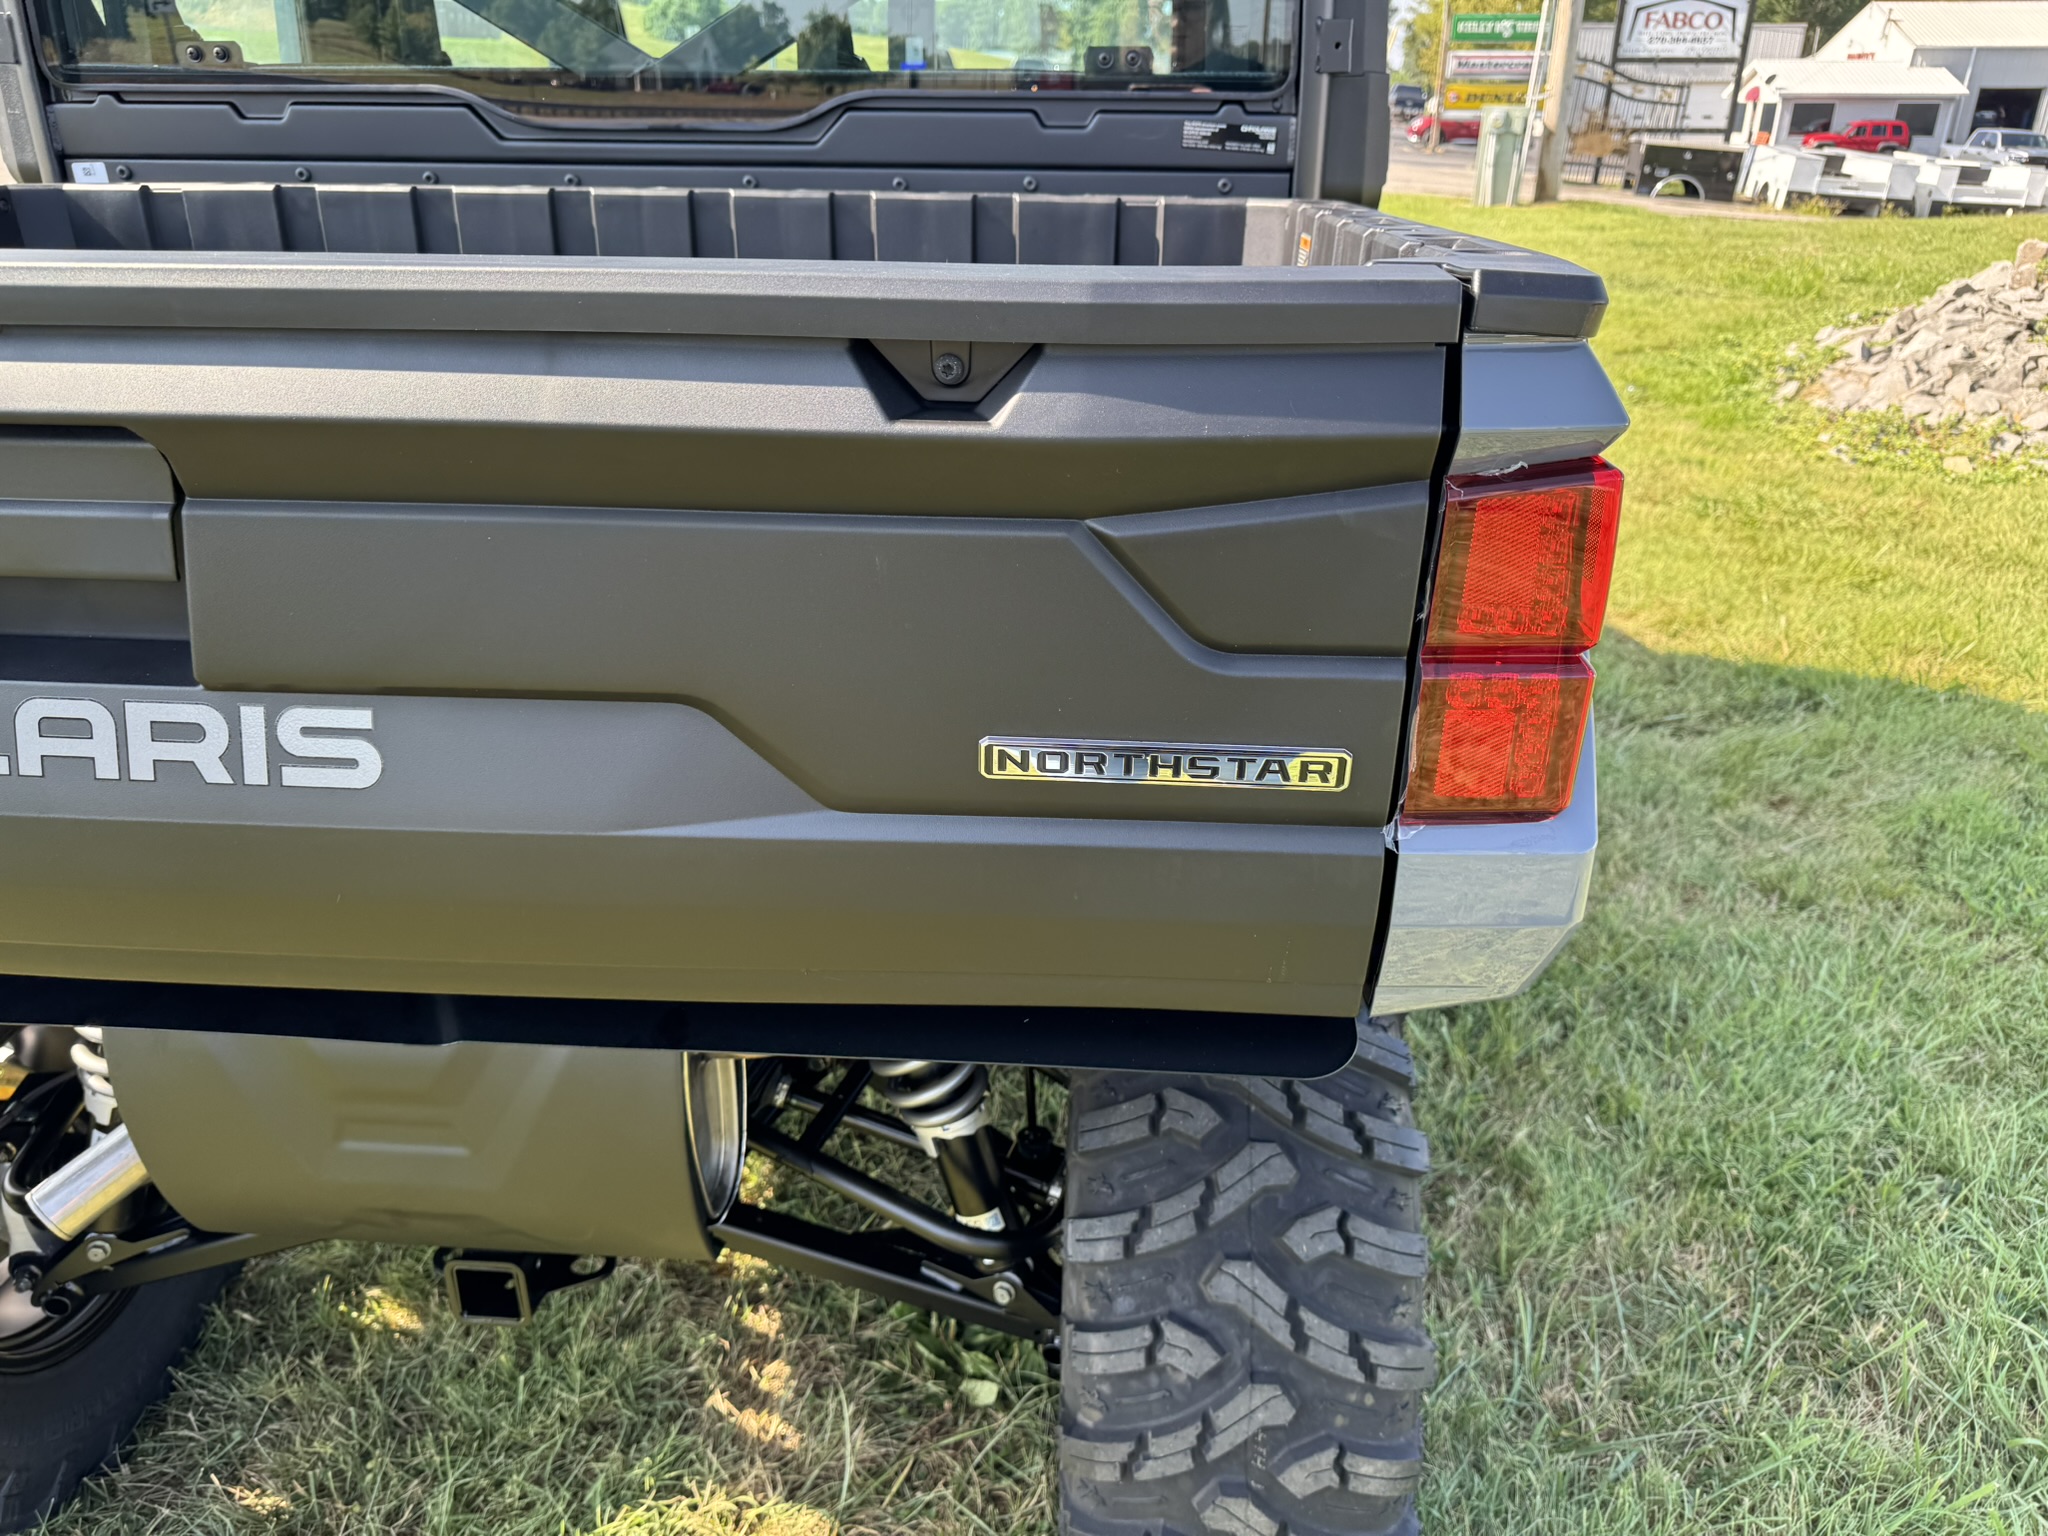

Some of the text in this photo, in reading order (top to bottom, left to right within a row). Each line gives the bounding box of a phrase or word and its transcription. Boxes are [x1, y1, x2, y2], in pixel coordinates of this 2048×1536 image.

[1644, 11, 1723, 30] FABCO
[0, 697, 384, 789] ARIS
[997, 748, 1334, 784] NORTHSTAR
